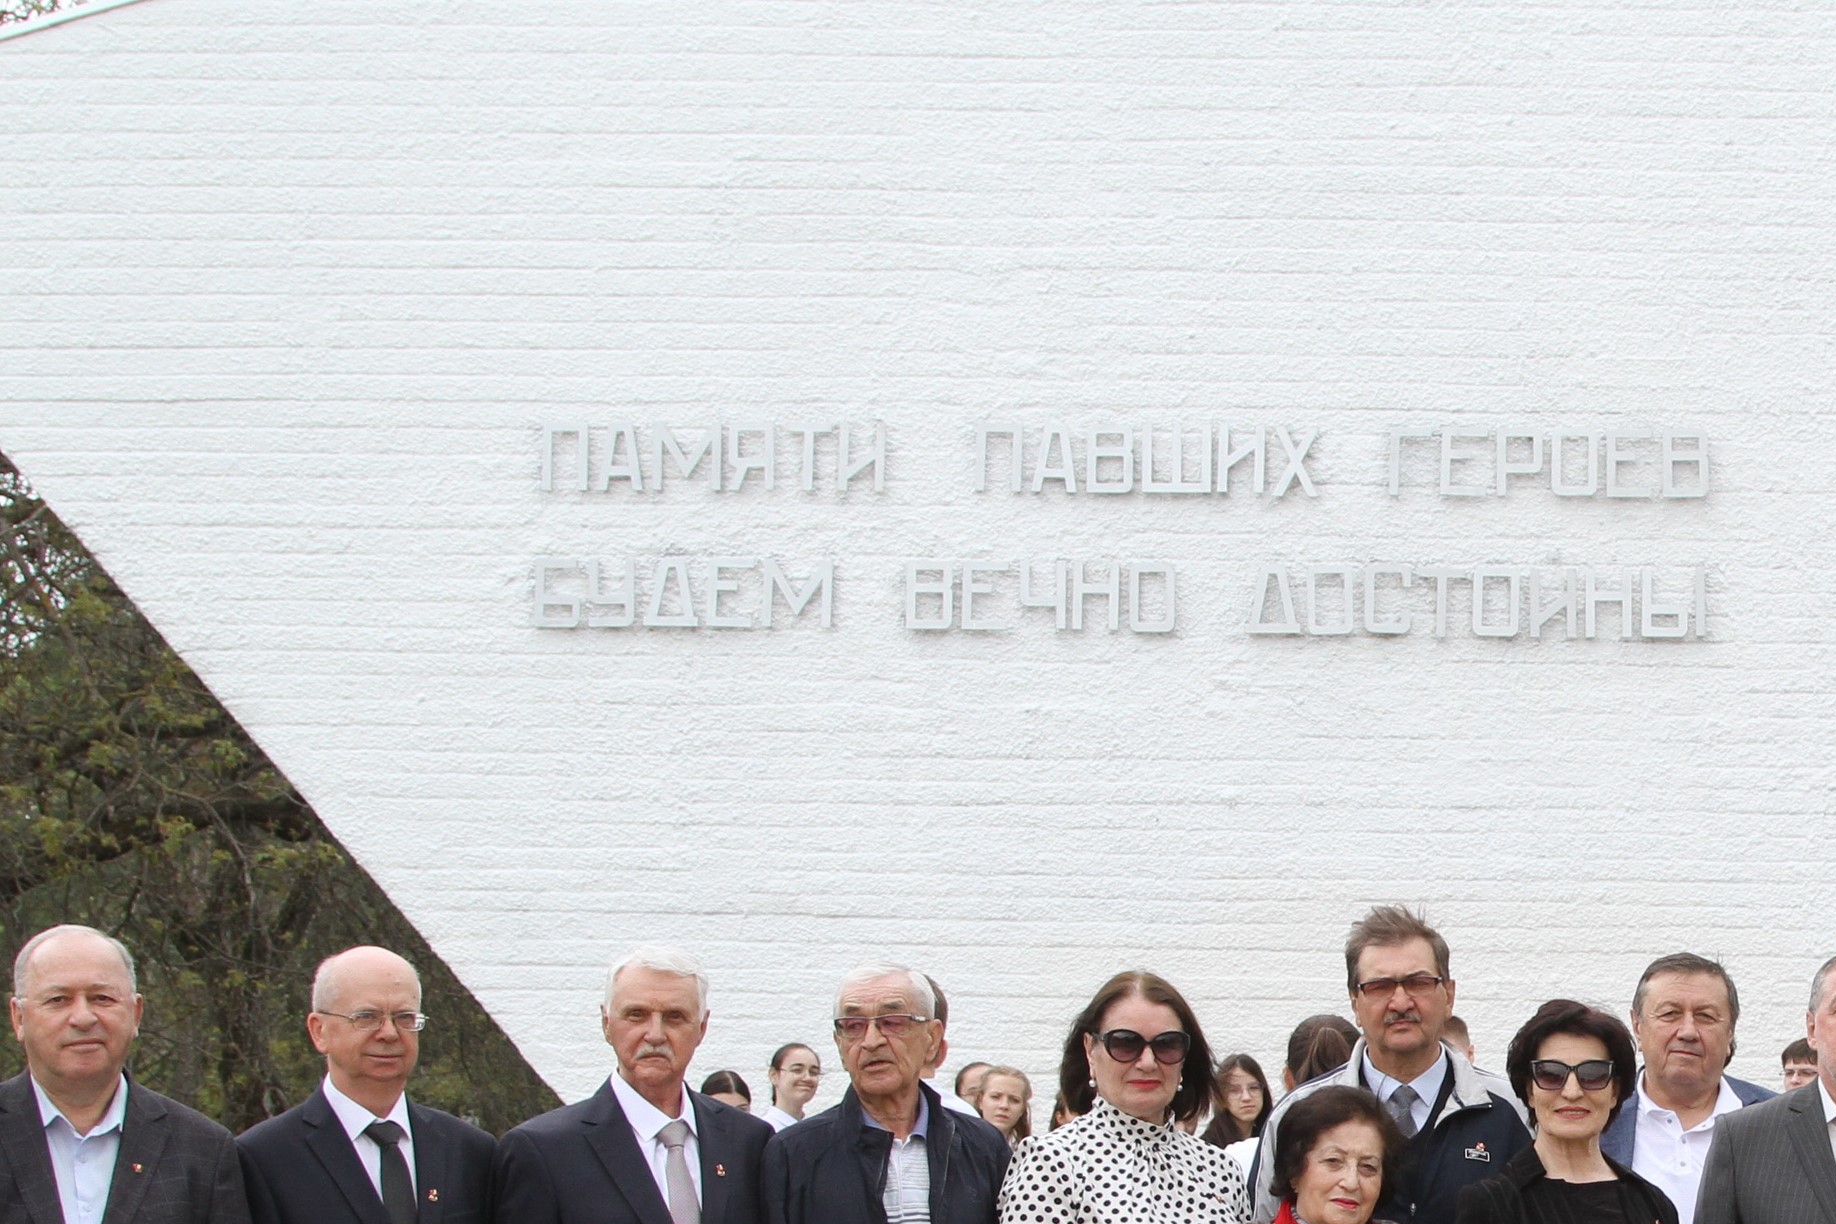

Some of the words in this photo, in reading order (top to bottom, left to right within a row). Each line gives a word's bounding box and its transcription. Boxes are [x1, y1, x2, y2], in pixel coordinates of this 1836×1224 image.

[540, 419, 886, 492] ПАМЯТИ
[973, 421, 1320, 498] ПАВШИХ
[1387, 424, 1709, 499] ГЕРОЕВ
[533, 557, 834, 628] БУДЕМ
[905, 557, 1176, 633] ВЕЧНО
